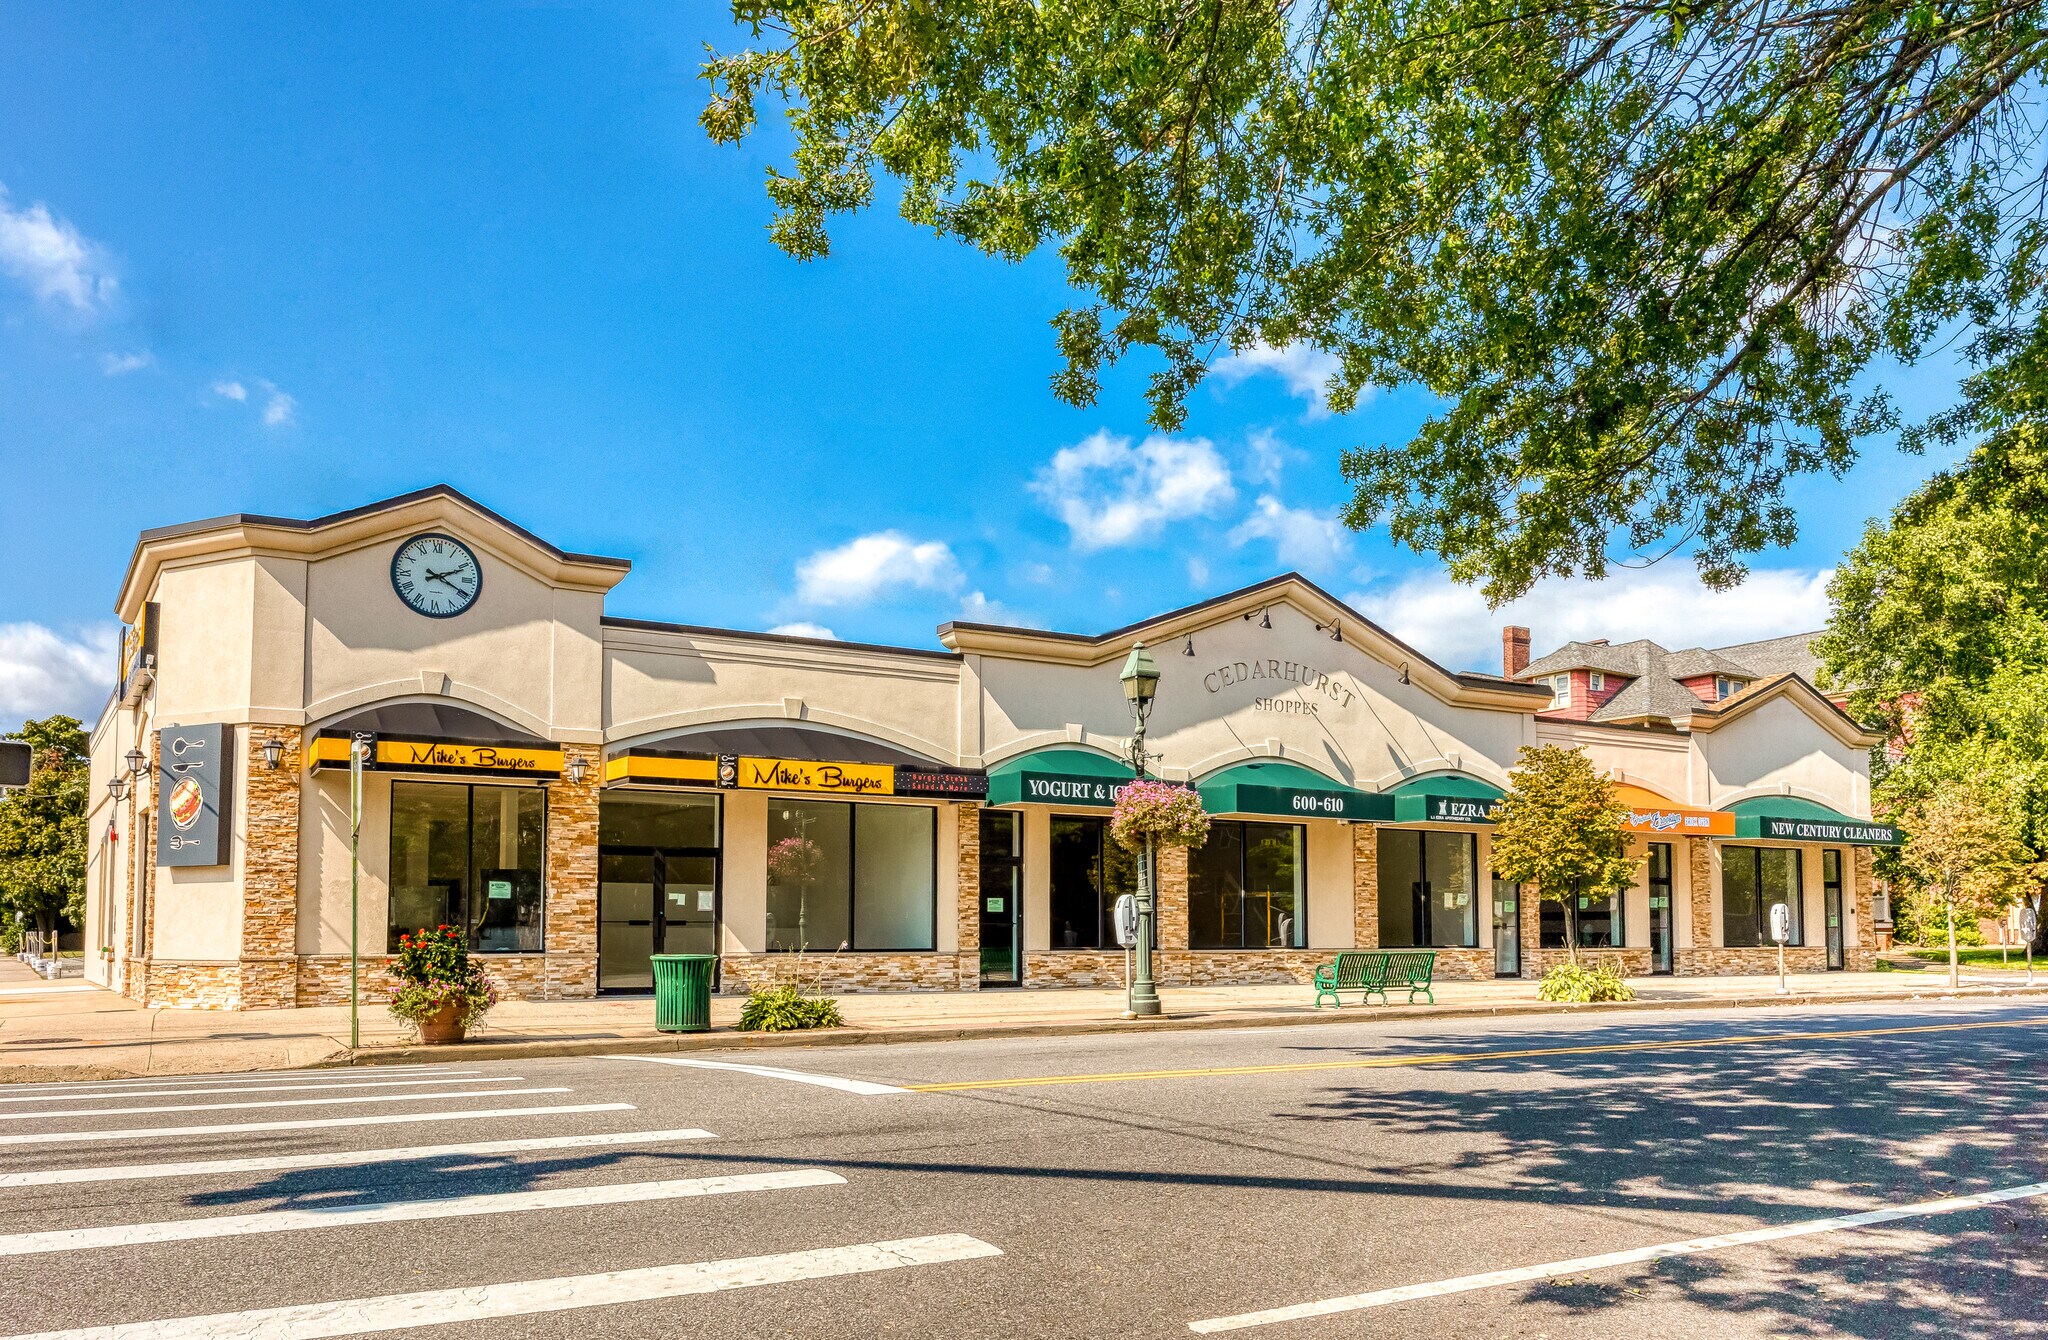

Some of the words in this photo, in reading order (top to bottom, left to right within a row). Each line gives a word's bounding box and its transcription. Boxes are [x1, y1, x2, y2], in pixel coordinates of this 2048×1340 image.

[1203, 659, 1356, 709] CEDARHURST
[1255, 697, 1319, 715] SHOPPES
[410, 743, 466, 765] Mike's
[472, 747, 536, 770] Burgers
[752, 761, 811, 786] Mike's
[817, 766, 882, 789] Burgers
[1028, 779, 1091, 799] YOGURT
[1094, 784, 1105, 799] &
[1292, 795, 1344, 812] 600-610
[1451, 803, 1486, 817] EZRA
[1771, 822, 1795, 836] NEW
[1796, 824, 1842, 838] CENTURY
[1843, 827, 1893, 841] CLEANERS
